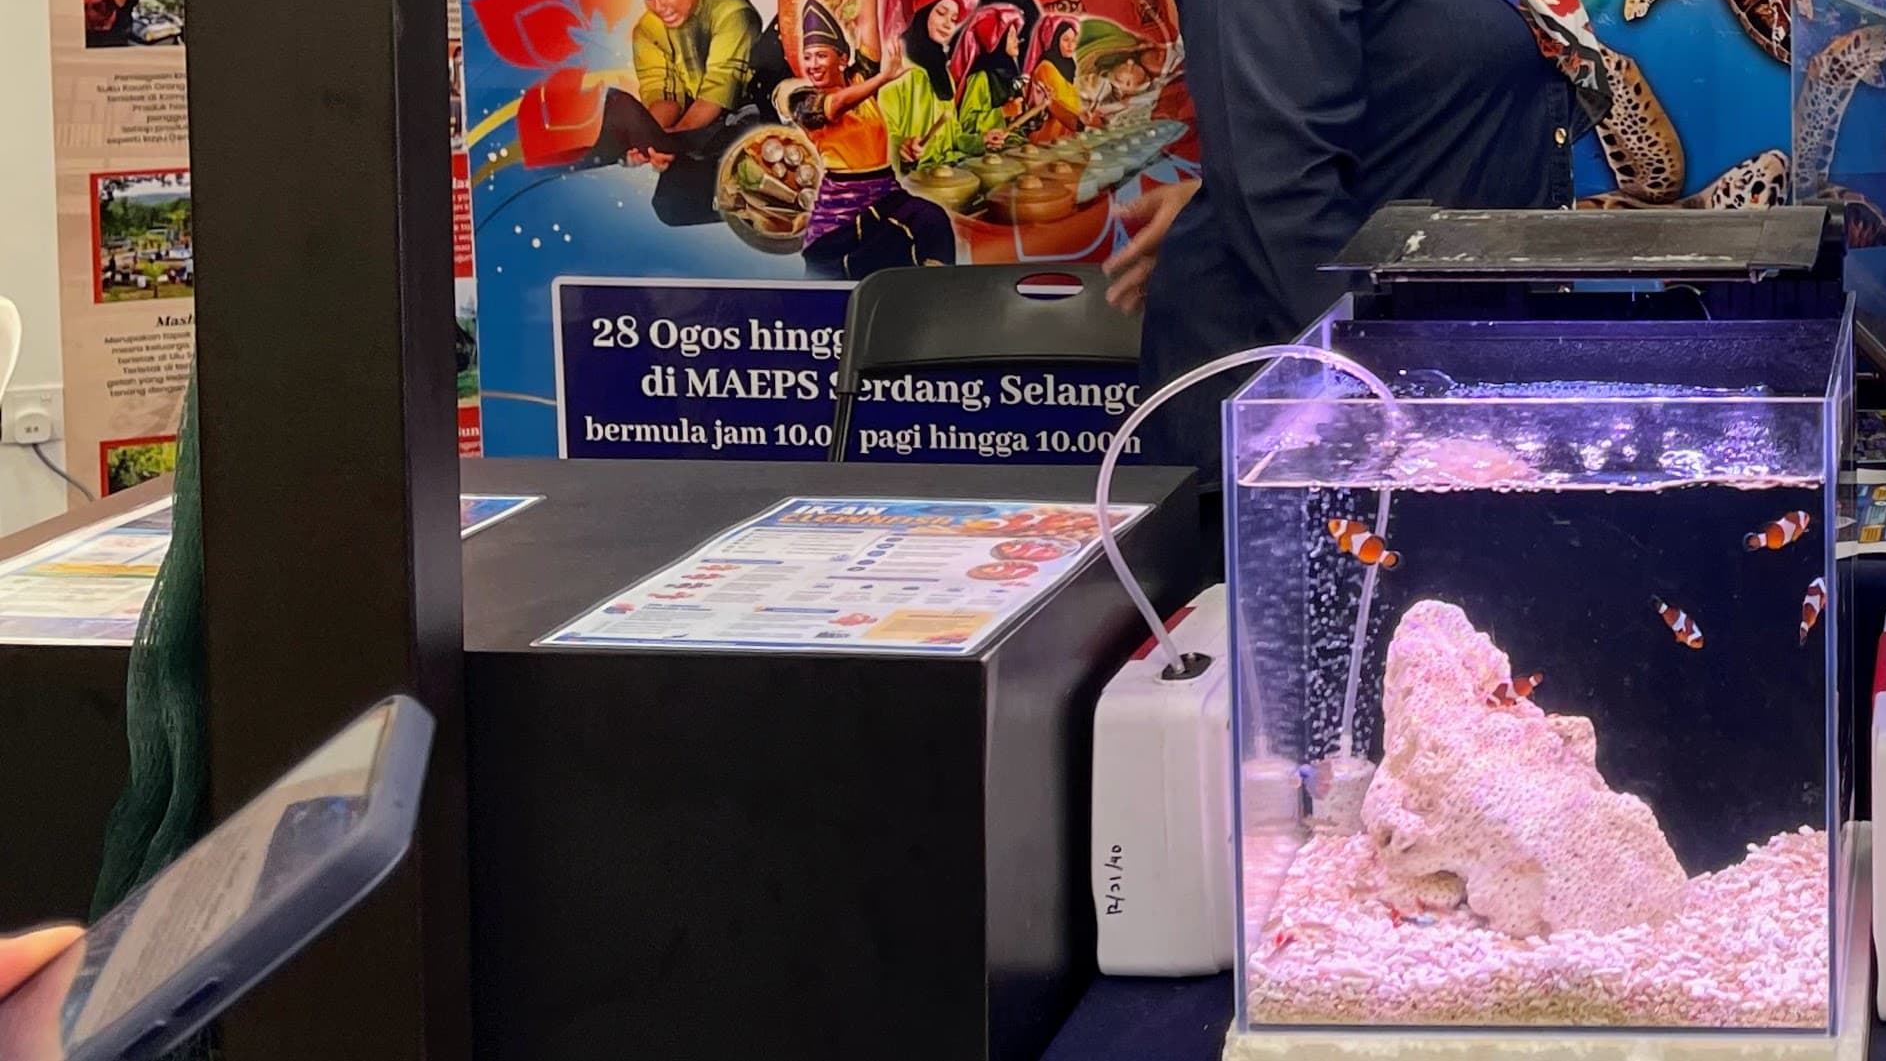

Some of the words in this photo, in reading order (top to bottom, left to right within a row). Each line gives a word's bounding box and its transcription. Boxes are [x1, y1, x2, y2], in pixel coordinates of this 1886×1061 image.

[592, 315, 640, 348] 28
[649, 318, 741, 358] Ogos
[748, 318, 846, 360] hing
[641, 365, 678, 397] di
[684, 367, 819, 400] MAEPS
[584, 415, 708, 444] bermula
[711, 419, 768, 450] jam
[773, 423, 833, 447] 10.0
[859, 424, 922, 455] pagi
[929, 424, 1029, 458] hingga
[792, 505, 889, 517] IKAN
